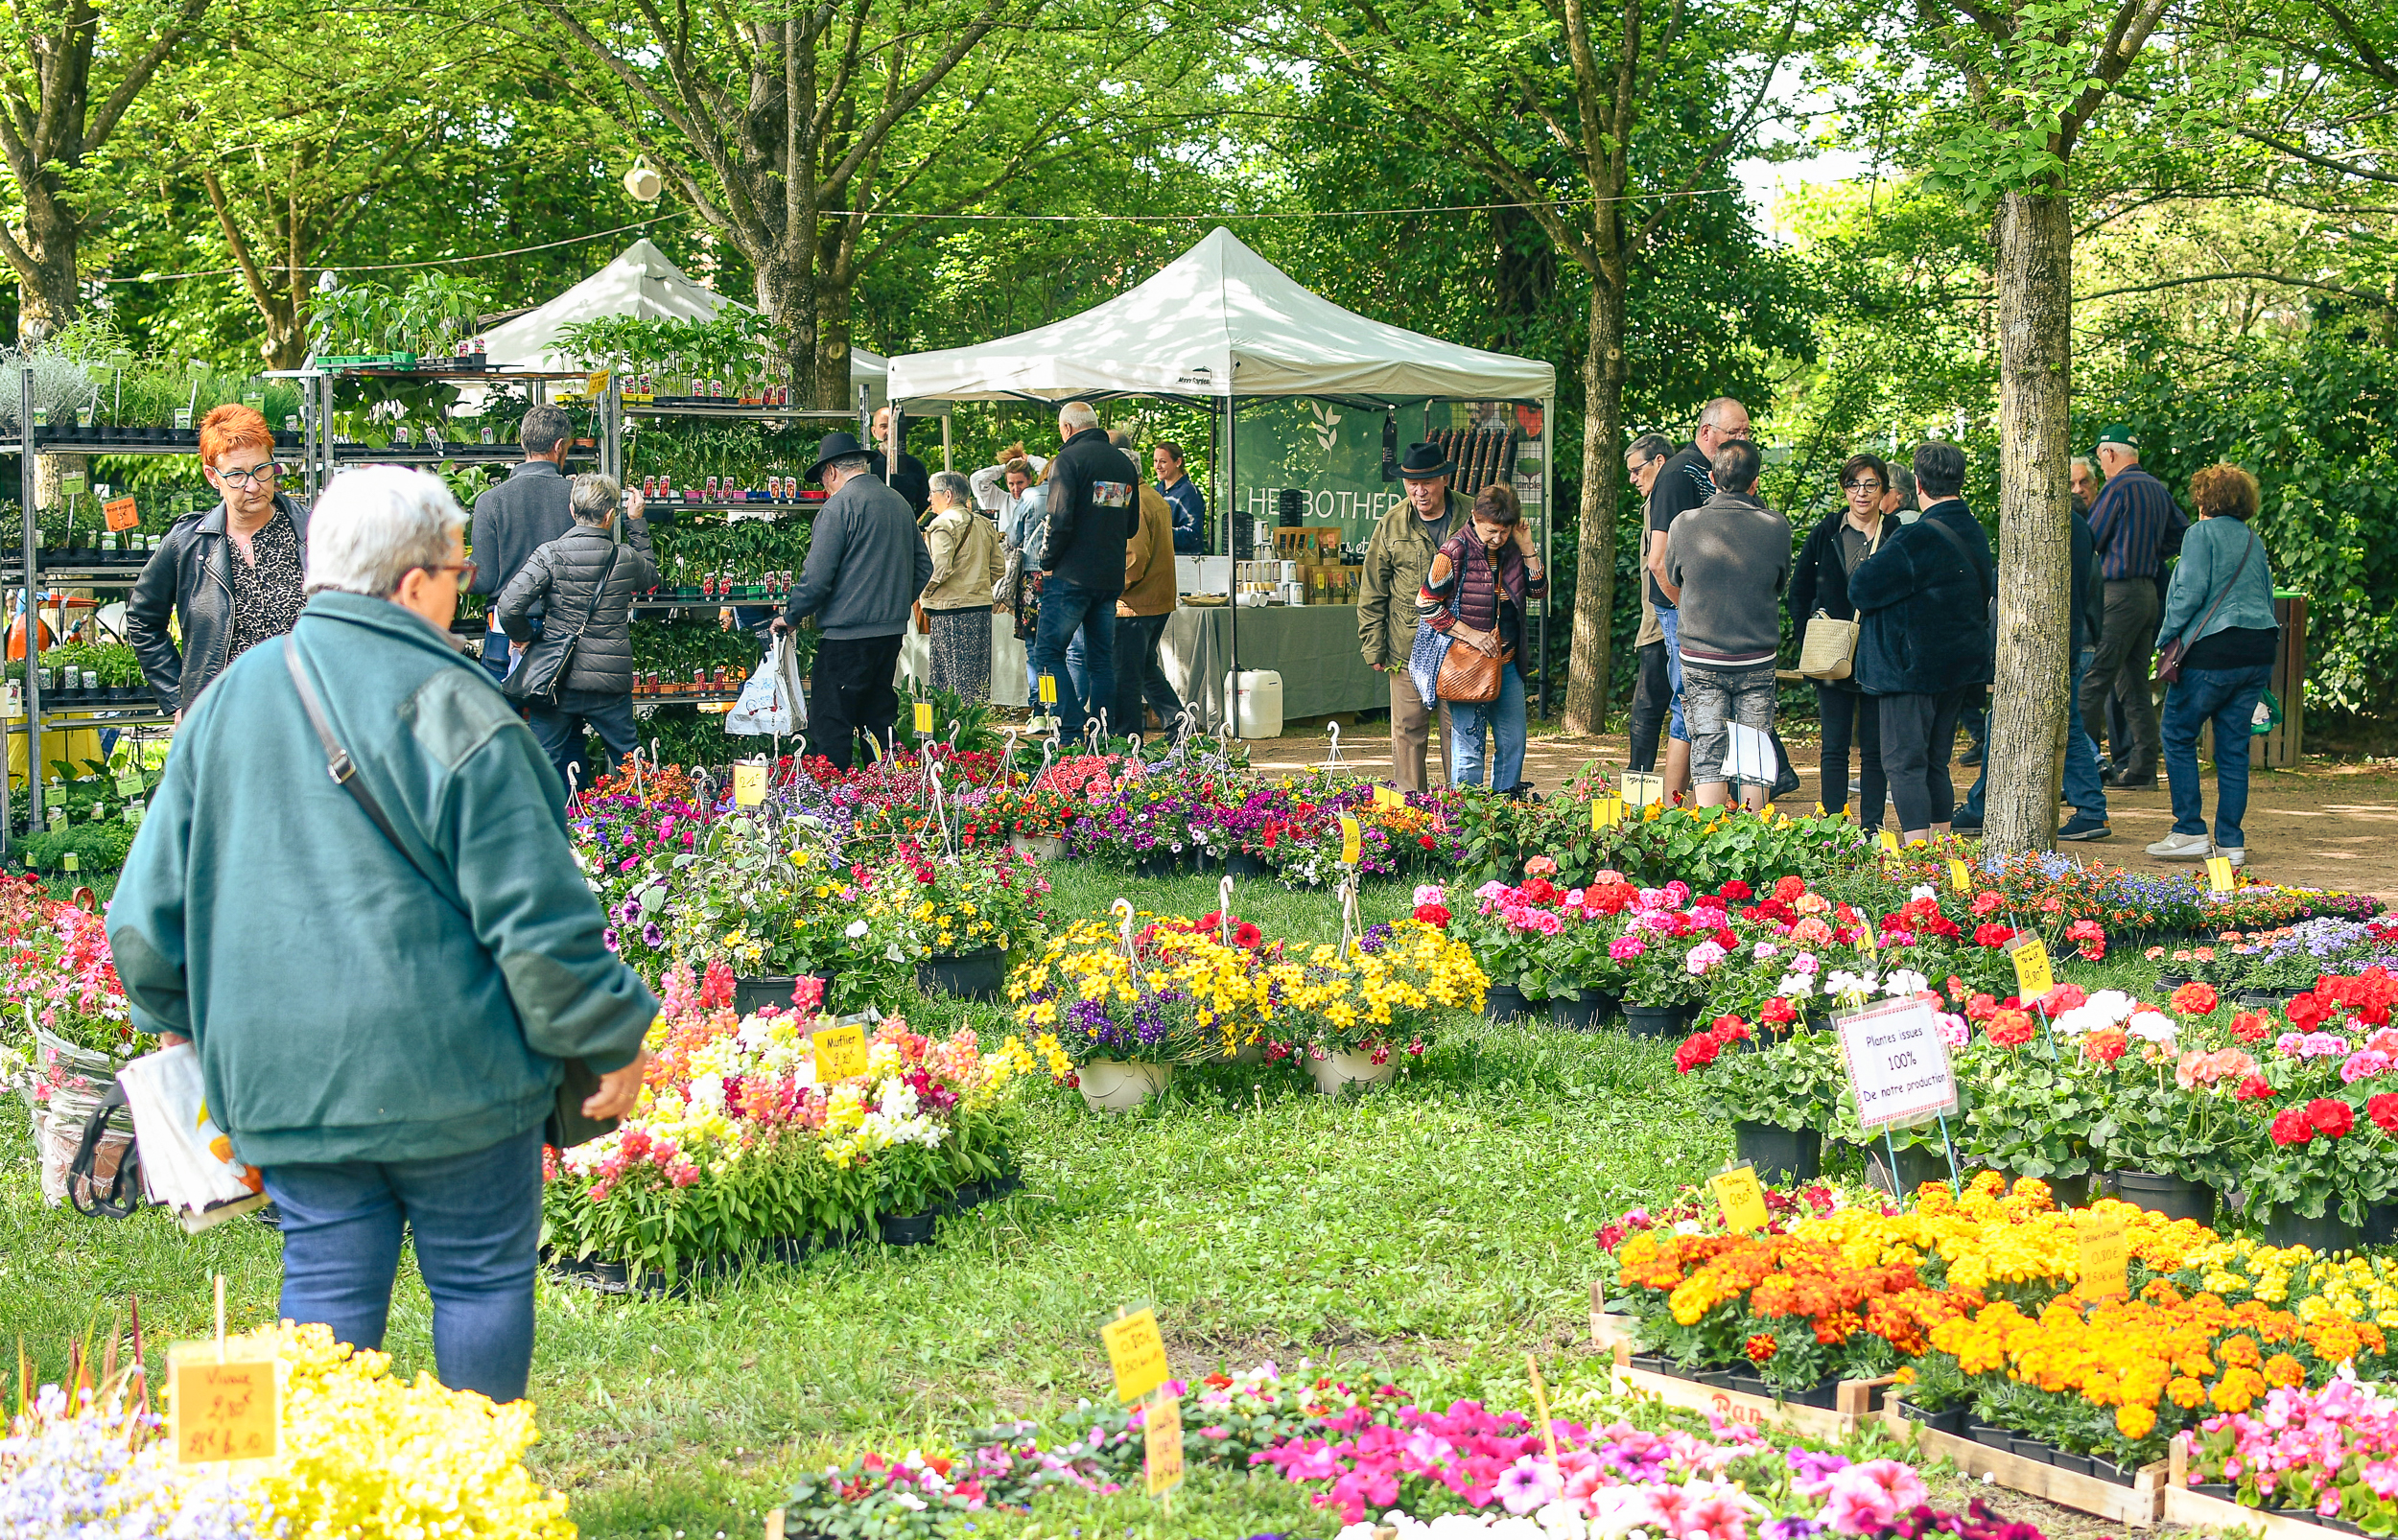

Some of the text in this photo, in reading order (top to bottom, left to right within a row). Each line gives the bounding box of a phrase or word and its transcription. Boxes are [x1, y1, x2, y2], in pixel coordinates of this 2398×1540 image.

[827, 1035, 857, 1049] Muflier
[1866, 1027, 1923, 1048] Plantes issues
[1888, 1051, 1917, 1071] 100%
[1863, 1072, 1946, 1103] De notre production
[2091, 1247, 2120, 1265] 0,80€
